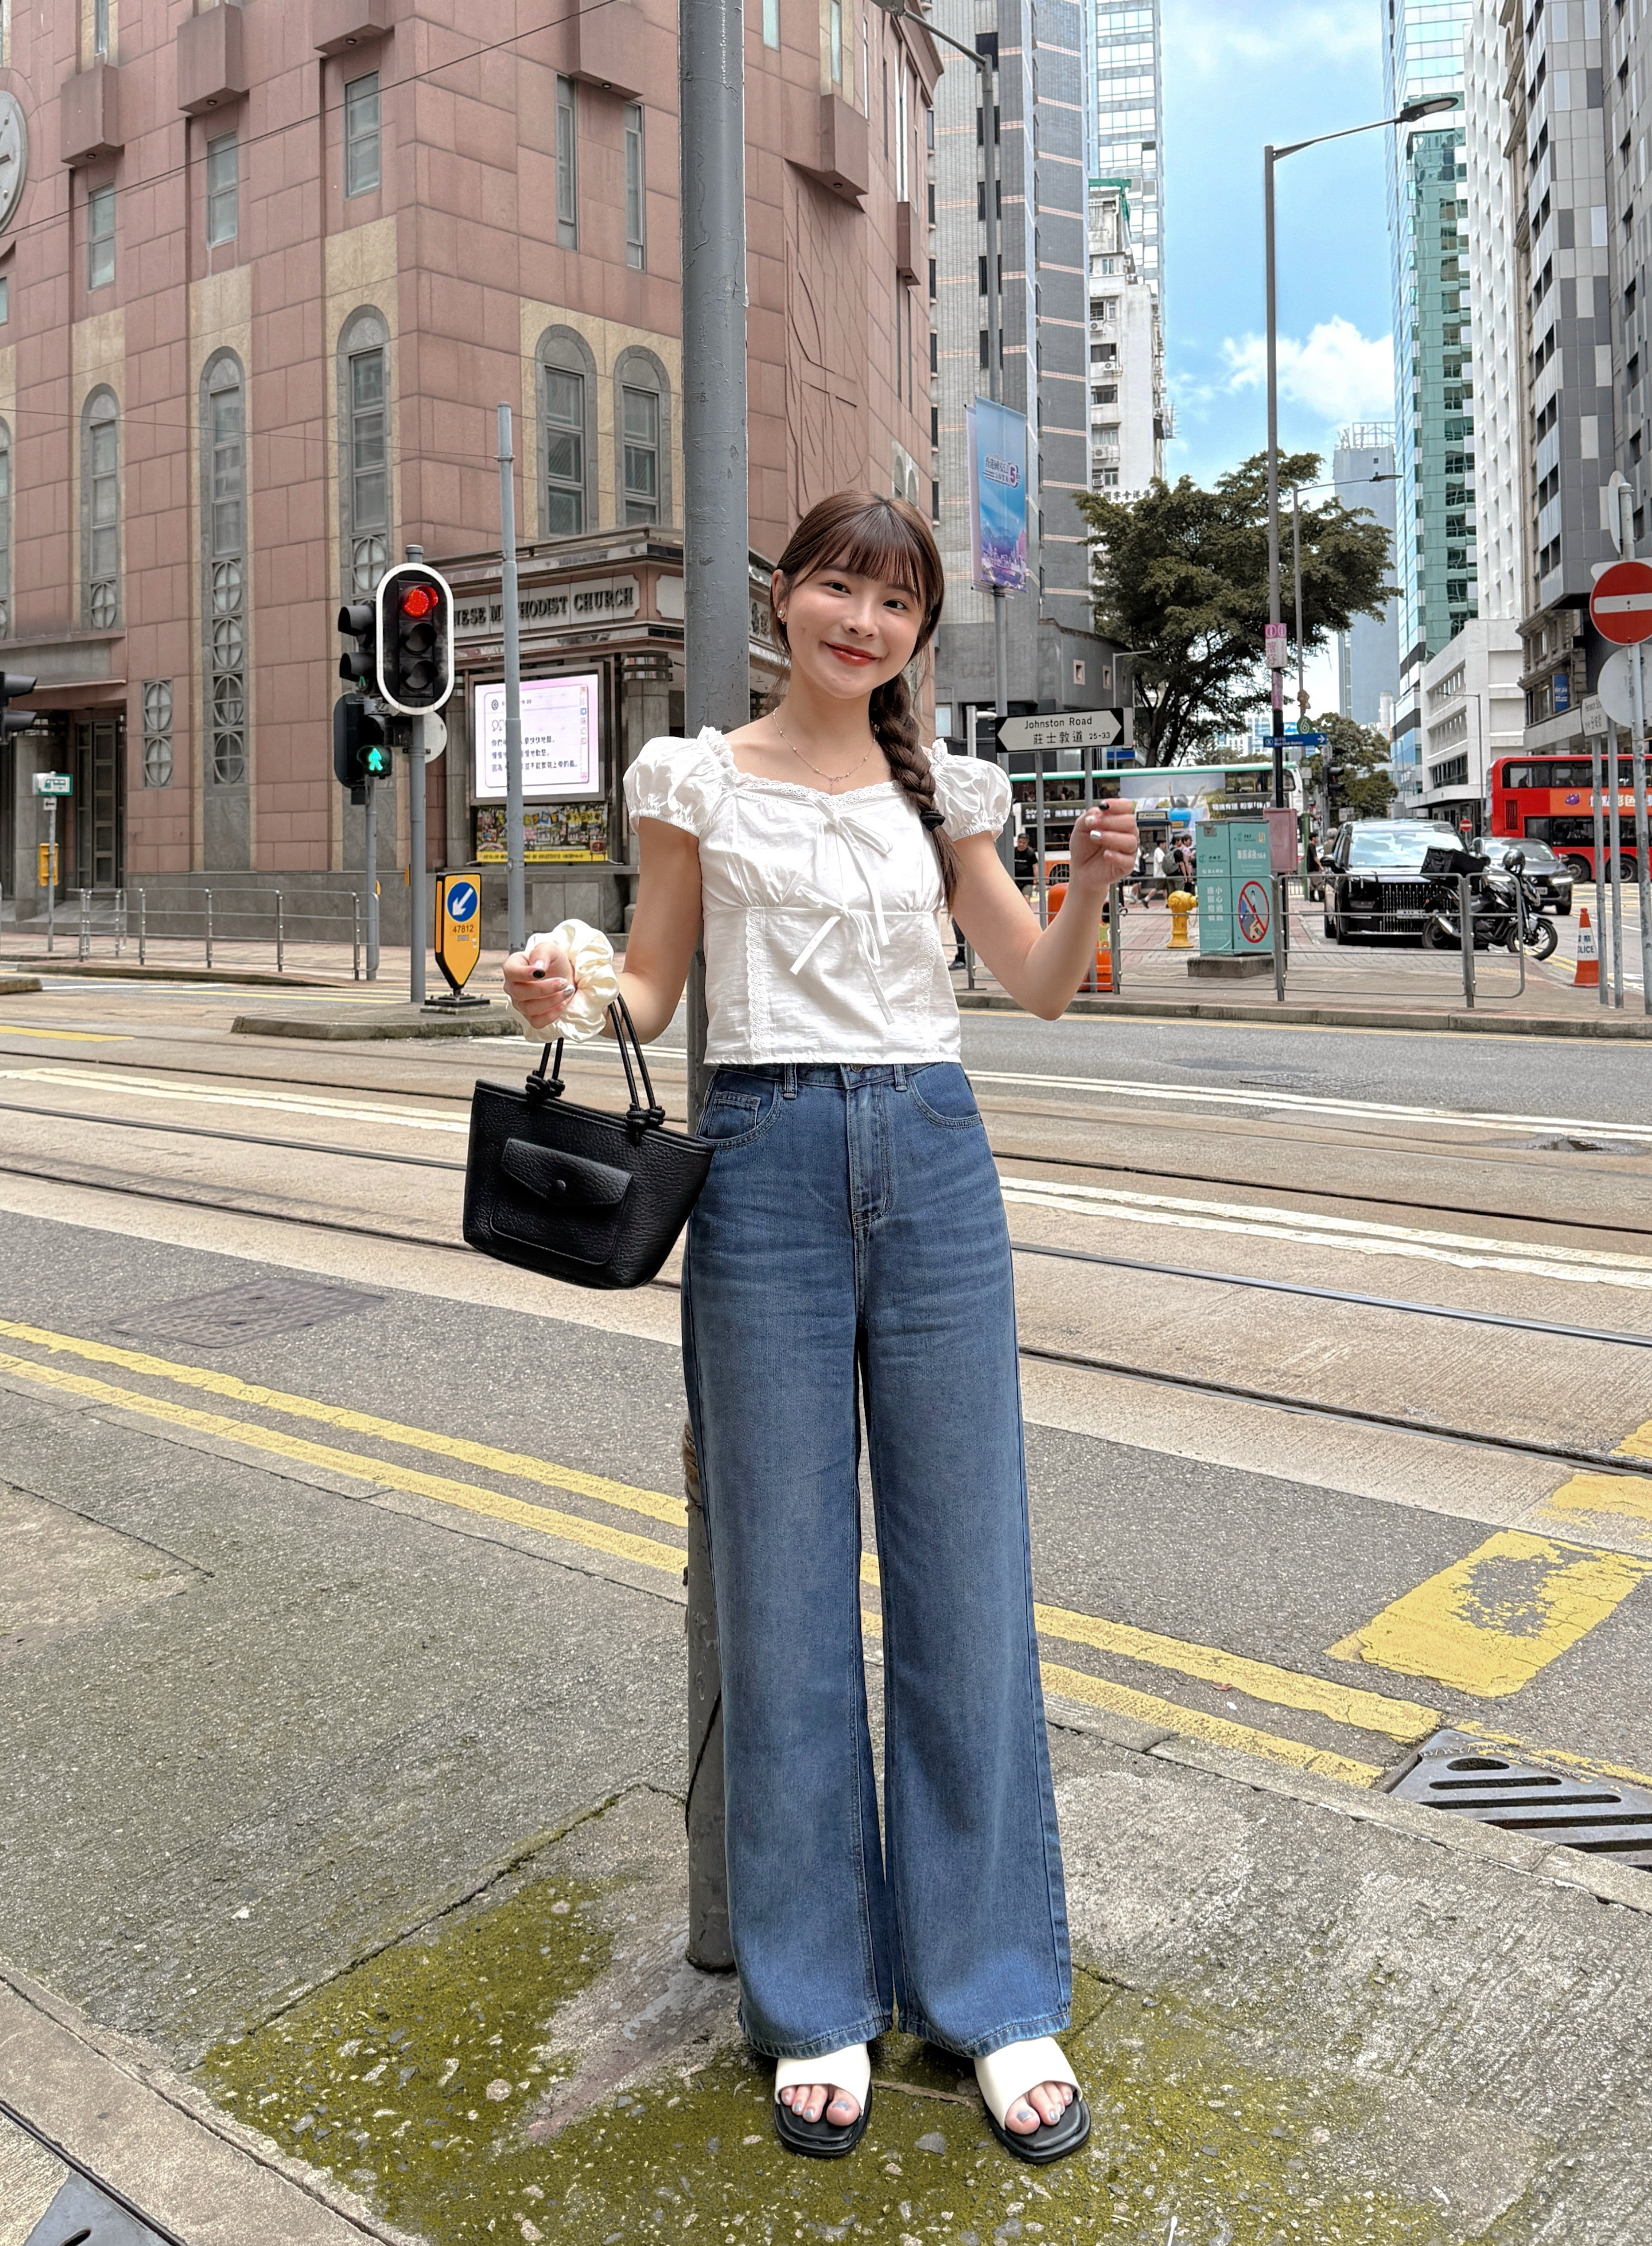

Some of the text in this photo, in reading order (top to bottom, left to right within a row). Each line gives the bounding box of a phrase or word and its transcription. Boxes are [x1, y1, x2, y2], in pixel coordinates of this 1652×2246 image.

[489, 595, 569, 622] MHODIST
[574, 586, 634, 612] CHURCH
[1024, 716, 1092, 729] Johnston Road
[1300, 718, 1310, 735] 6
[1033, 730, 1083, 745] 莊士敦道
[452, 924, 474, 933] 47812
